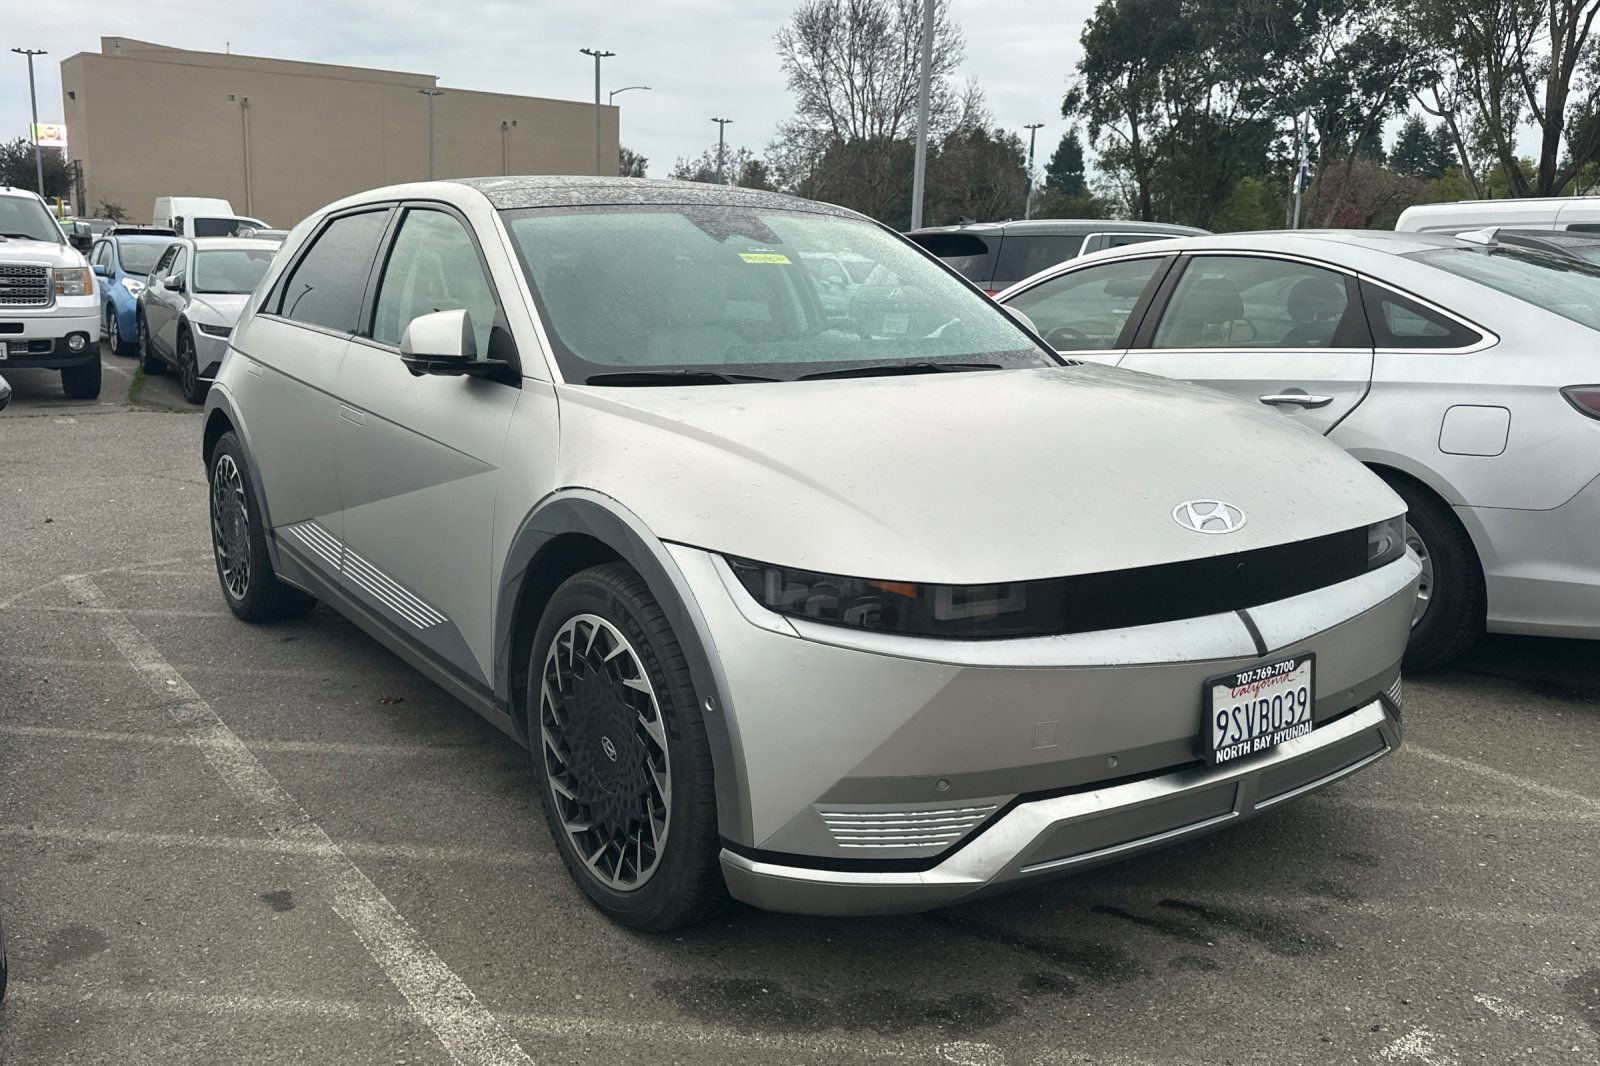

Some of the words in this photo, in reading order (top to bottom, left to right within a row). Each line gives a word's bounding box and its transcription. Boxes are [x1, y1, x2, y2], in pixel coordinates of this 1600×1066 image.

[1231, 673, 1295, 698] California
[1237, 660, 1295, 685] 707-769-7700
[1216, 687, 1307, 749] 9SVB039
[1216, 741, 1251, 764] NORTH
[1254, 735, 1271, 752] BAY
[1273, 721, 1313, 745] HYUNDAI
